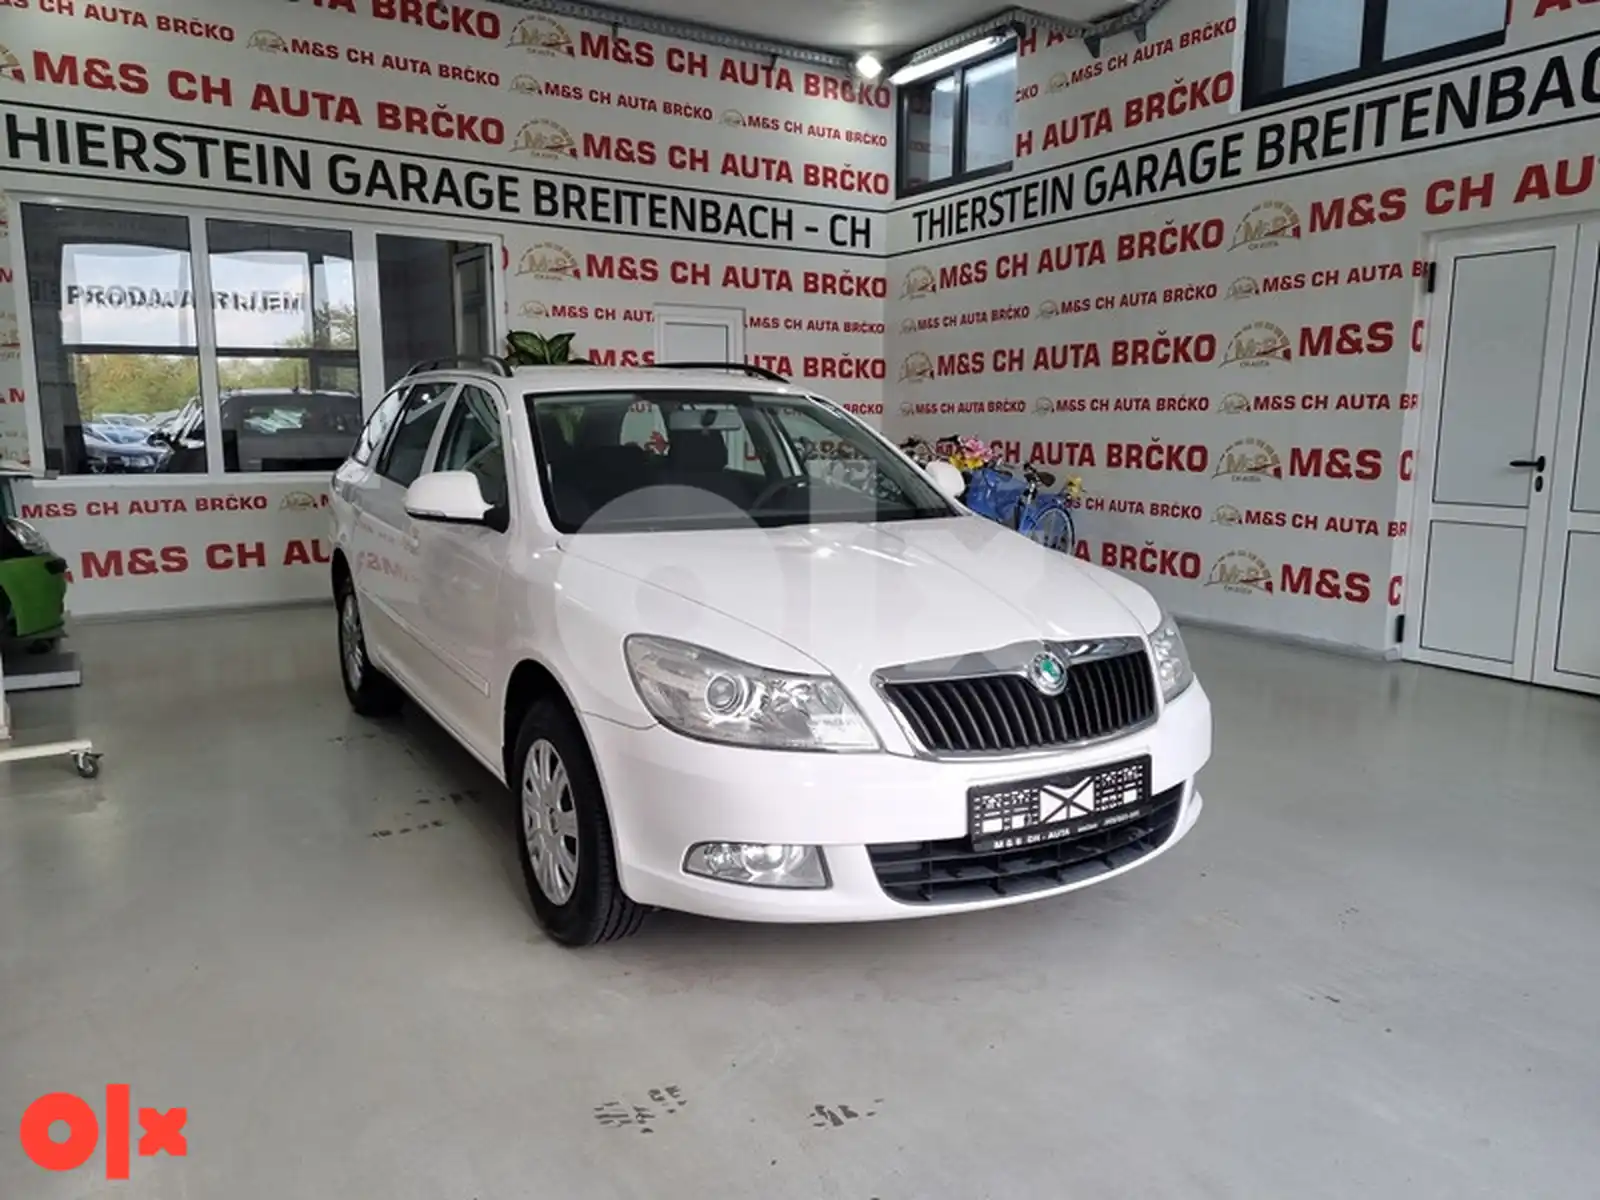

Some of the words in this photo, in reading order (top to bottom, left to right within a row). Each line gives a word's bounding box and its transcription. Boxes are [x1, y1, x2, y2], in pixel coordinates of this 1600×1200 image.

[84, 4, 148, 28] AUTA
[156, 16, 234, 42] BRČKO
[291, 39, 339, 60] M&S
[346, 48, 374, 66] CH
[382, 55, 432, 76] AUTA
[581, 32, 654, 67] M&S
[666, 48, 708, 78] CH
[720, 59, 793, 92] AUTA
[1071, 62, 1103, 84] M&S
[1108, 54, 1128, 72] CH
[1132, 39, 1173, 64] AUTA
[33, 50, 149, 94] M&S
[168, 70, 232, 107] CH
[250, 83, 362, 126] AUTA
[377, 102, 504, 145] BRČKO
[545, 82, 583, 100] M&S
[589, 89, 611, 104] CH
[616, 94, 657, 112] AUTA
[1042, 107, 1112, 151] AUTA
[1124, 72, 1233, 128] BRČKO
[784, 120, 802, 134] CH
[808, 125, 840, 140] AUTA
[583, 132, 656, 165] M&S
[668, 145, 709, 172] CH
[720, 152, 793, 184] AUTA
[804, 164, 889, 195] BRČKO
[327, 152, 522, 214] GARAGE
[531, 178, 796, 243] BREITENBACH
[828, 214, 873, 248] CH
[912, 172, 1076, 243] THIERSTEIN
[1084, 132, 1246, 206] GARAGE
[1309, 188, 1407, 233] M&S
[1426, 172, 1494, 215] CH
[1513, 154, 1600, 203] AU
[940, 260, 988, 289] M&S
[996, 252, 1028, 279] CH
[1037, 239, 1105, 274] AUTA
[1117, 219, 1224, 262] BRČKO
[586, 254, 659, 282] M&S
[670, 261, 710, 286] CH
[721, 265, 793, 292] AUTA
[804, 271, 887, 298] BRČKO
[1263, 273, 1306, 292] M&S
[1312, 270, 1339, 287] CH
[1347, 263, 1403, 284] AUTA
[1412, 260, 1432, 282] B
[552, 305, 588, 319] M&S
[594, 308, 616, 320] CH
[623, 309, 655, 322] AUT
[1095, 296, 1115, 310] CH
[1120, 291, 1157, 307] AUTA
[784, 318, 802, 330] CH
[806, 320, 840, 332] AUTA
[1299, 321, 1394, 357] M&S
[803, 353, 886, 379] BRČKO
[937, 352, 984, 376] M&S
[993, 348, 1024, 372] CH
[1032, 343, 1100, 371] AUTA
[1112, 331, 1216, 367] BRČKO
[1090, 398, 1109, 412] CH
[1114, 398, 1151, 411] AUTA
[1254, 395, 1296, 411] M&S
[1301, 395, 1328, 410] CH
[1335, 394, 1390, 410] AUTA
[1028, 440, 1097, 469] AUTA
[1106, 438, 1208, 472] BRČKO
[1289, 448, 1382, 480] M&S
[22, 503, 77, 518] M&S
[86, 501, 119, 516] CH
[128, 499, 187, 515] AUTA
[1086, 497, 1104, 511] CH
[1109, 500, 1144, 515] AUTA
[1245, 510, 1287, 527] M&S
[1292, 513, 1318, 530] CH
[1325, 517, 1379, 536] AUTA
[80, 546, 188, 578] M&S
[206, 542, 266, 570] CH
[1101, 542, 1201, 579] BRČKO
[1280, 564, 1371, 603] M&S
